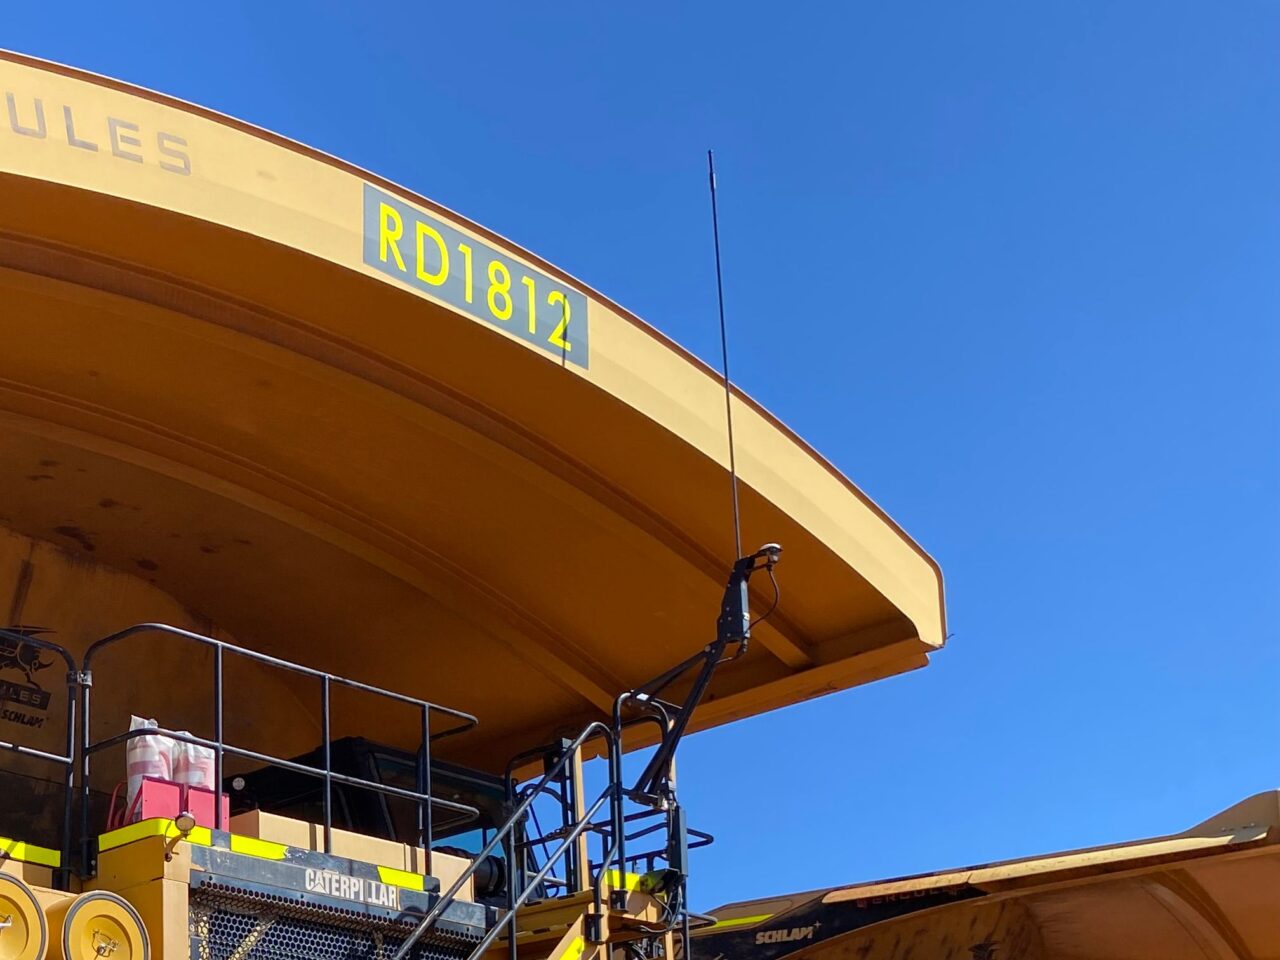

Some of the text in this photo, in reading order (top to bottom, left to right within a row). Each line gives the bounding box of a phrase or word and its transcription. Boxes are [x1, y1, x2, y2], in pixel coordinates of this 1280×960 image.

[379, 202, 572, 352] RD1812
[305, 868, 397, 911] CATERPILAR
[755, 926, 814, 945] SCHLAM
